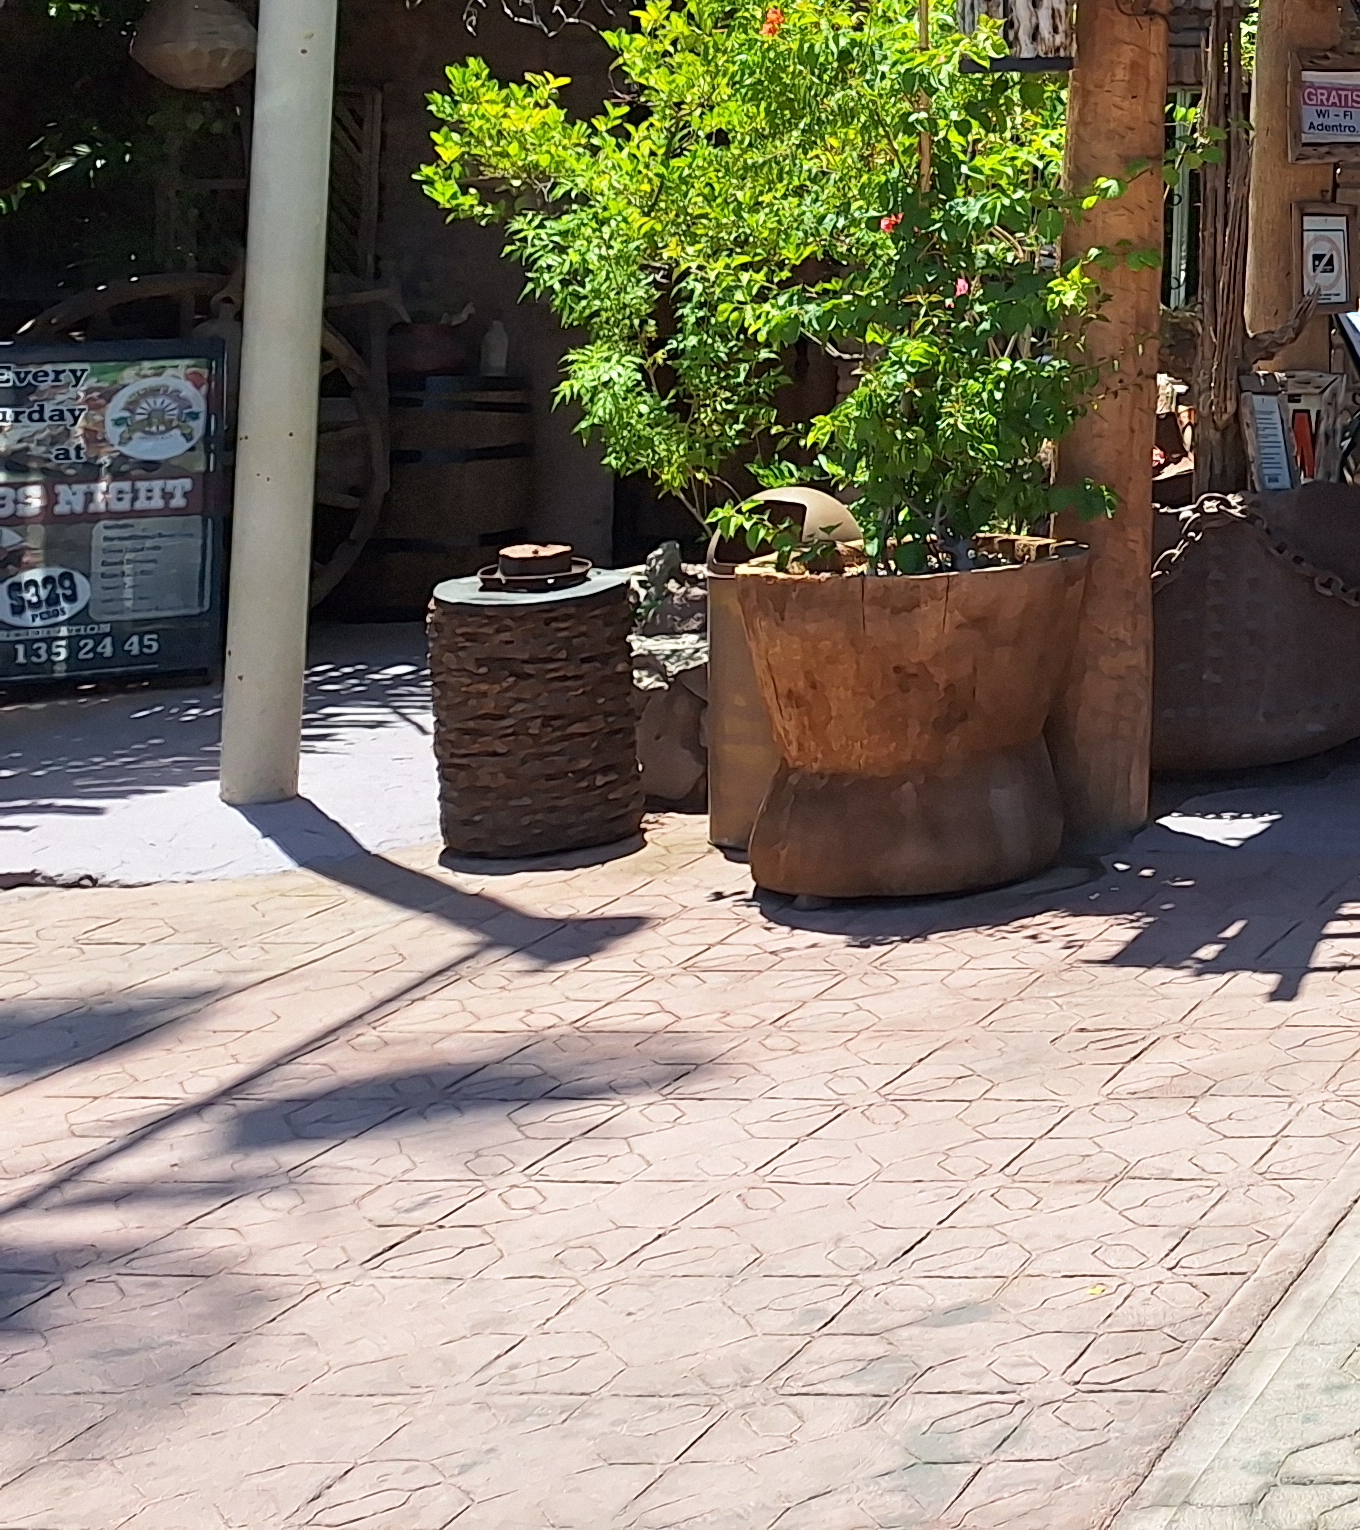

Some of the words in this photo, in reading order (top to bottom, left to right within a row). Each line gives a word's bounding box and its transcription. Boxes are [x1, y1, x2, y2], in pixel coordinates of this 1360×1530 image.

[54, 443, 85, 461] at
[53, 477, 193, 516] NIGHT
[31, 606, 67, 623] PESOS
[14, 638, 69, 664] 135
[77, 635, 114, 660] 24
[123, 633, 160, 656] 45
